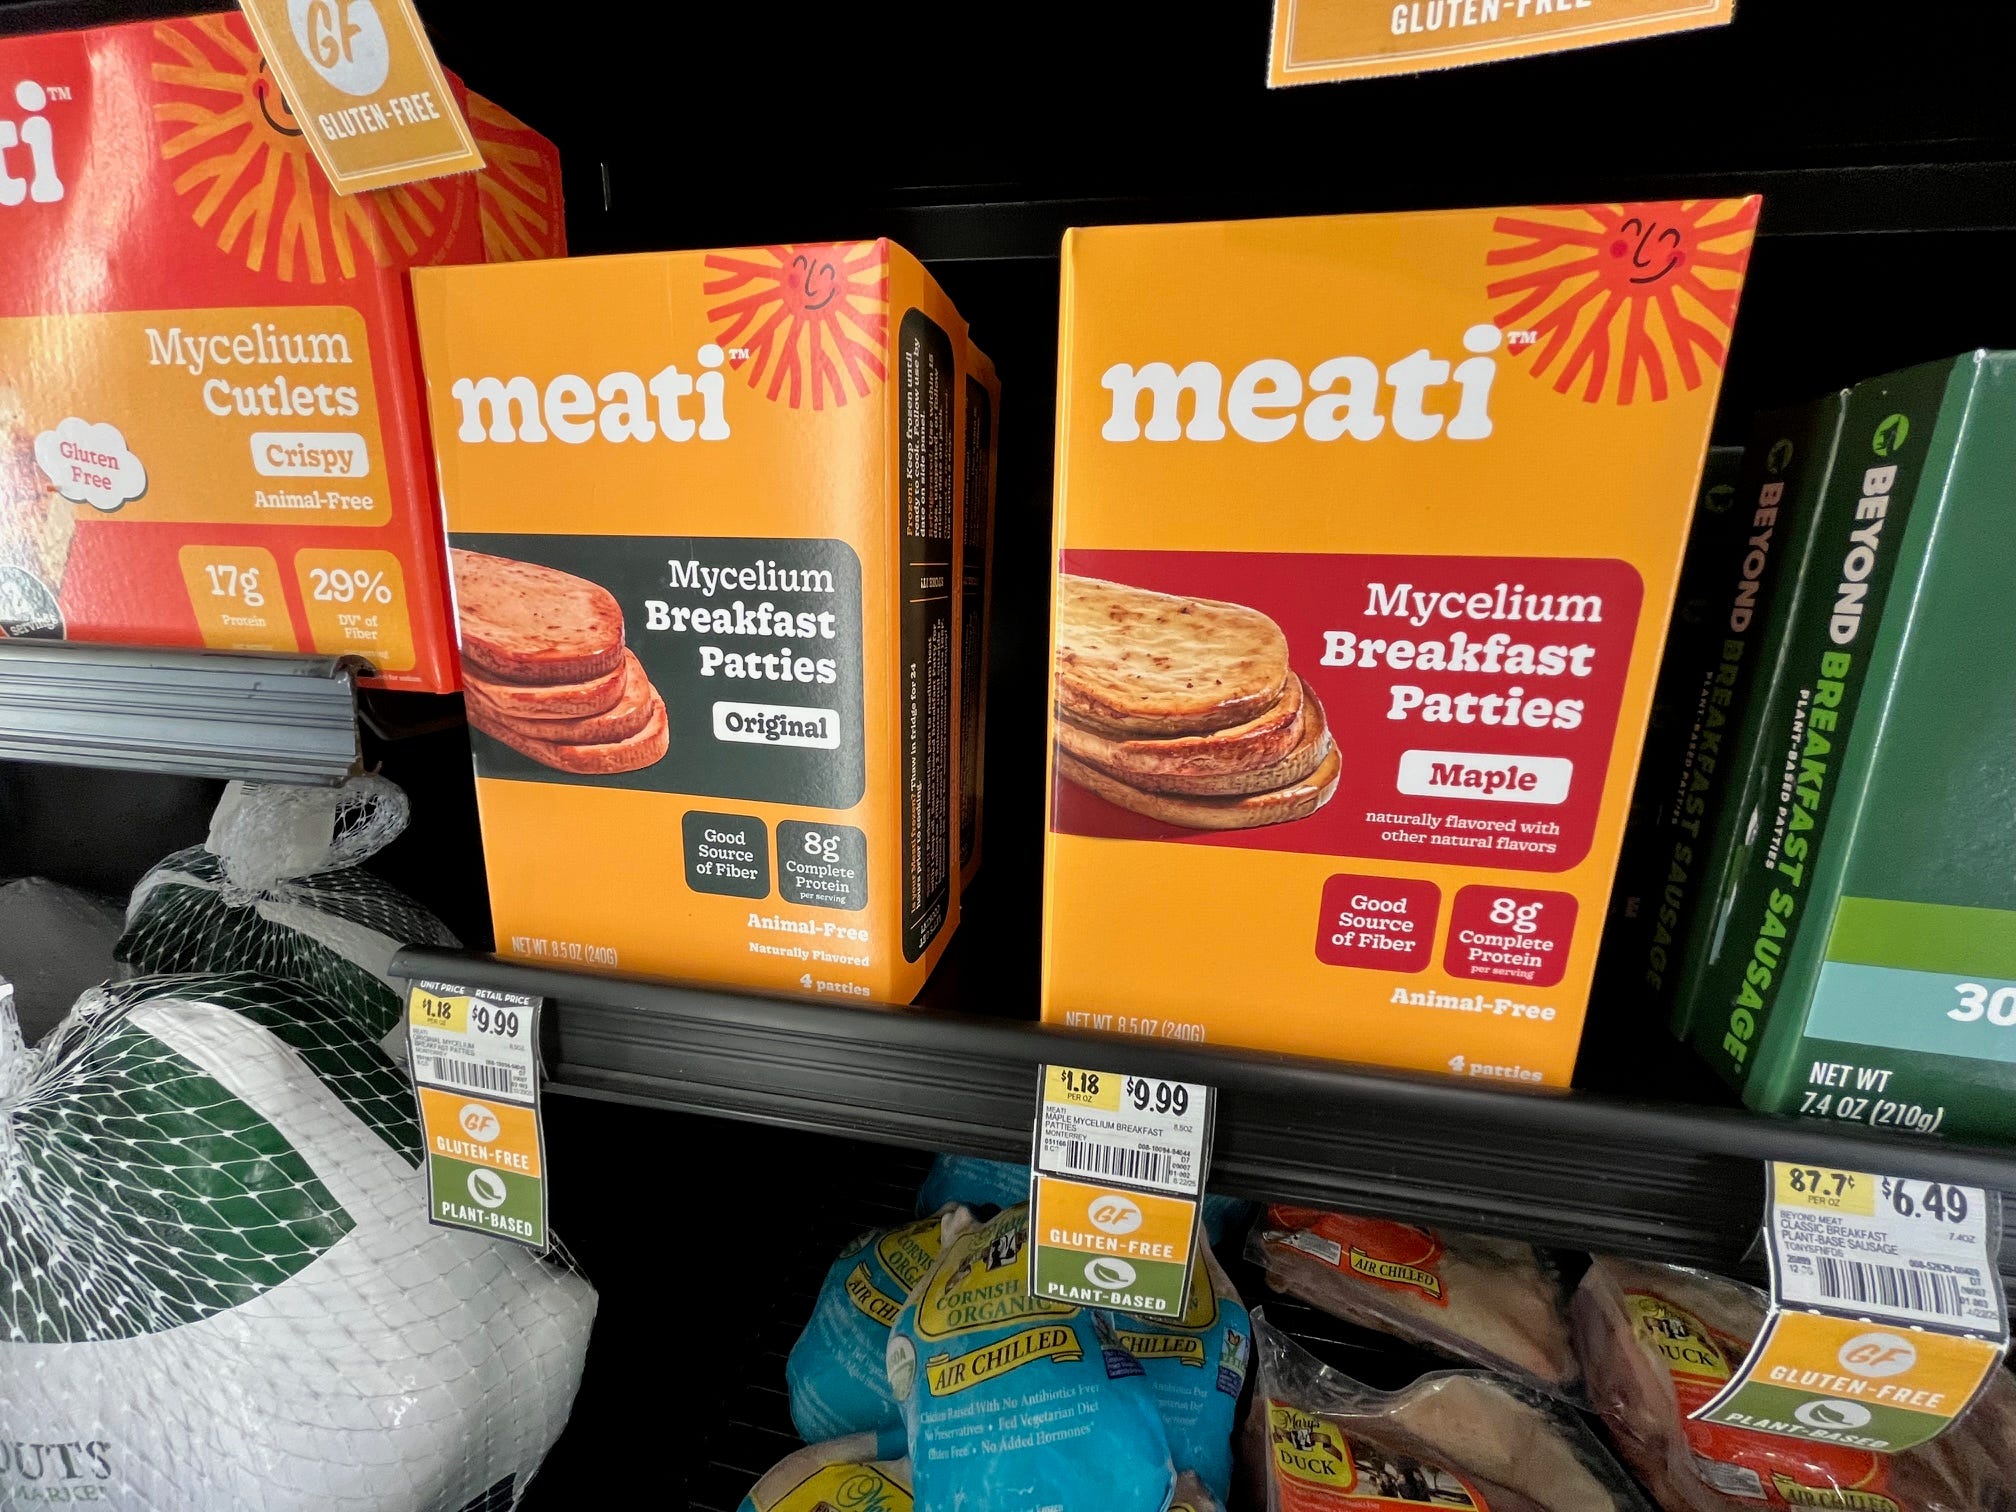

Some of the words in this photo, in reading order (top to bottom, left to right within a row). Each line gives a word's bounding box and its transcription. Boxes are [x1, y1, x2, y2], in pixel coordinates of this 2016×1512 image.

[318, 92, 440, 141] GLUTEN-FREE
[145, 327, 352, 374] Mycelium
[203, 375, 359, 417] Cutlets
[451, 344, 730, 443] meati
[1100, 323, 1502, 443] meati
[59, 441, 119, 471] Gluten
[266, 443, 353, 473] Crispy
[906, 442, 914, 479] Keep
[72, 467, 111, 491] Free
[255, 490, 373, 511] Animal-Free
[1731, 481, 1785, 633] BEYOND
[1829, 464, 1898, 645] BEYOND
[205, 565, 260, 606] 17g
[309, 568, 391, 604] 29%
[668, 560, 835, 598] Mycelium
[1364, 583, 1602, 625] Mycelium
[10, 612, 58, 637] servings
[222, 614, 267, 627] Protein
[345, 627, 378, 640] Fiber
[365, 615, 378, 627] of
[646, 600, 837, 640] Breakfast
[699, 646, 837, 684] Patties
[1320, 631, 1595, 677] Breakfast
[1387, 685, 1584, 729] Patties
[725, 711, 828, 742] Original
[1779, 690, 1810, 803] PLANT-BASED
[1429, 764, 1537, 794] Maple
[1779, 651, 1852, 887] BREAKFAST
[704, 829, 746, 846] Good
[1365, 812, 1442, 831] naturally
[1445, 814, 1517, 835] flavored
[1521, 819, 1560, 836] with
[1765, 805, 1788, 870] PATTIES
[698, 845, 754, 863] Source
[804, 831, 840, 863] 8g
[1381, 828, 1426, 844] other
[1431, 831, 1492, 849] natural
[1496, 834, 1556, 854] flavors
[696, 860, 713, 876] of
[716, 862, 758, 881] Fiber
[786, 860, 855, 880] Complete
[796, 875, 850, 894] Protein
[800, 892, 815, 901] per
[816, 893, 846, 905] serving
[1351, 895, 1407, 915] Good
[747, 913, 869, 942] Animal-Free
[1339, 911, 1414, 934] Source
[1490, 898, 1543, 934] 8g
[512, 936, 531, 955] NET
[551, 941, 568, 959] 8.5
[569, 943, 582, 961] OZ
[585, 944, 618, 967] (240G)
[749, 942, 808, 962] Naturally
[813, 949, 870, 967] Flavored
[1332, 930, 1354, 948] of
[1358, 932, 1416, 953] Fiber
[1459, 930, 1555, 953] Complete
[1469, 948, 1542, 968] Protein
[420, 980, 440, 990] UNIT
[441, 984, 465, 995] PRICE
[800, 973, 812, 989] 4
[817, 978, 871, 996] patties
[1470, 966, 1490, 977] per
[1492, 967, 1534, 981] serving
[422, 998, 452, 1020] $1.18
[475, 989, 503, 1001] RETAIL
[505, 994, 531, 1006] PRICE
[1391, 986, 1556, 1022] Animal-Free
[472, 1005, 519, 1038] $9.99
[1066, 1011, 1090, 1027] NET
[1140, 1019, 1158, 1036] OZ
[1448, 1054, 1465, 1071] 4
[1468, 1060, 1543, 1082] patties
[1809, 1061, 1854, 1088] NET
[1856, 1067, 1894, 1092] WT
[1061, 1070, 1100, 1096] $1.18
[1127, 1076, 1189, 1117] $9.99
[1046, 1106, 1066, 1114] MEATI
[1067, 1093, 1081, 1102] PER
[1082, 1096, 1093, 1104] OZ
[1799, 1091, 1833, 1115] 7.4
[1836, 1096, 1869, 1120] OZ
[1869, 1099, 1945, 1133] (210g)
[464, 1113, 494, 1132] GF
[1045, 1113, 1072, 1123] MAPLE
[1073, 1117, 1115, 1129] MYCELIUM
[1117, 1123, 1164, 1136] BREAKFAST
[1045, 1121, 1077, 1132] PATTIES
[437, 1135, 529, 1170] GLUTEN-FREE
[1808, 1196, 1825, 1205] PER
[1828, 1198, 1841, 1207] OZ
[1882, 1176, 1968, 1224] $6.49
[442, 1201, 533, 1237] PLANT-BASED
[1093, 1206, 1136, 1225] GF
[1780, 1210, 1816, 1223] BEYOND
[1818, 1214, 1843, 1226] MEAT
[1050, 1228, 1173, 1258] GLUTEN-FREE
[1781, 1219, 1824, 1234] CLASSIC
[1826, 1226, 1887, 1242] BREAKFAST
[1782, 1230, 1845, 1246] PLANT-BASE
[1847, 1239, 1899, 1255] SAUSAGE
[1355, 1257, 1377, 1274] AIR
[1379, 1264, 1435, 1286] CHILLED
[847, 1279, 867, 1307] AIR
[936, 1279, 1019, 1311] CORNISH
[1048, 1282, 1166, 1311] PLANT-BASED
[934, 1363, 966, 1391] AIR
[972, 1329, 1068, 1376] CHILLED
[975, 1398, 1000, 1416] With
[1002, 1397, 1018, 1409] No
[1021, 1387, 1076, 1406] Antibiotics
[1769, 1365, 1944, 1409] GLUTEN-FREE
[998, 1414, 1018, 1430] Fed
[1021, 1406, 1075, 1428] Vegetarian
[1077, 1400, 1100, 1414] Diet
[981, 1440, 998, 1454] No
[998, 1433, 1034, 1453] Added
[1725, 1413, 1889, 1449] PLANT-BASED
[1280, 1450, 1337, 1476] DUCK
